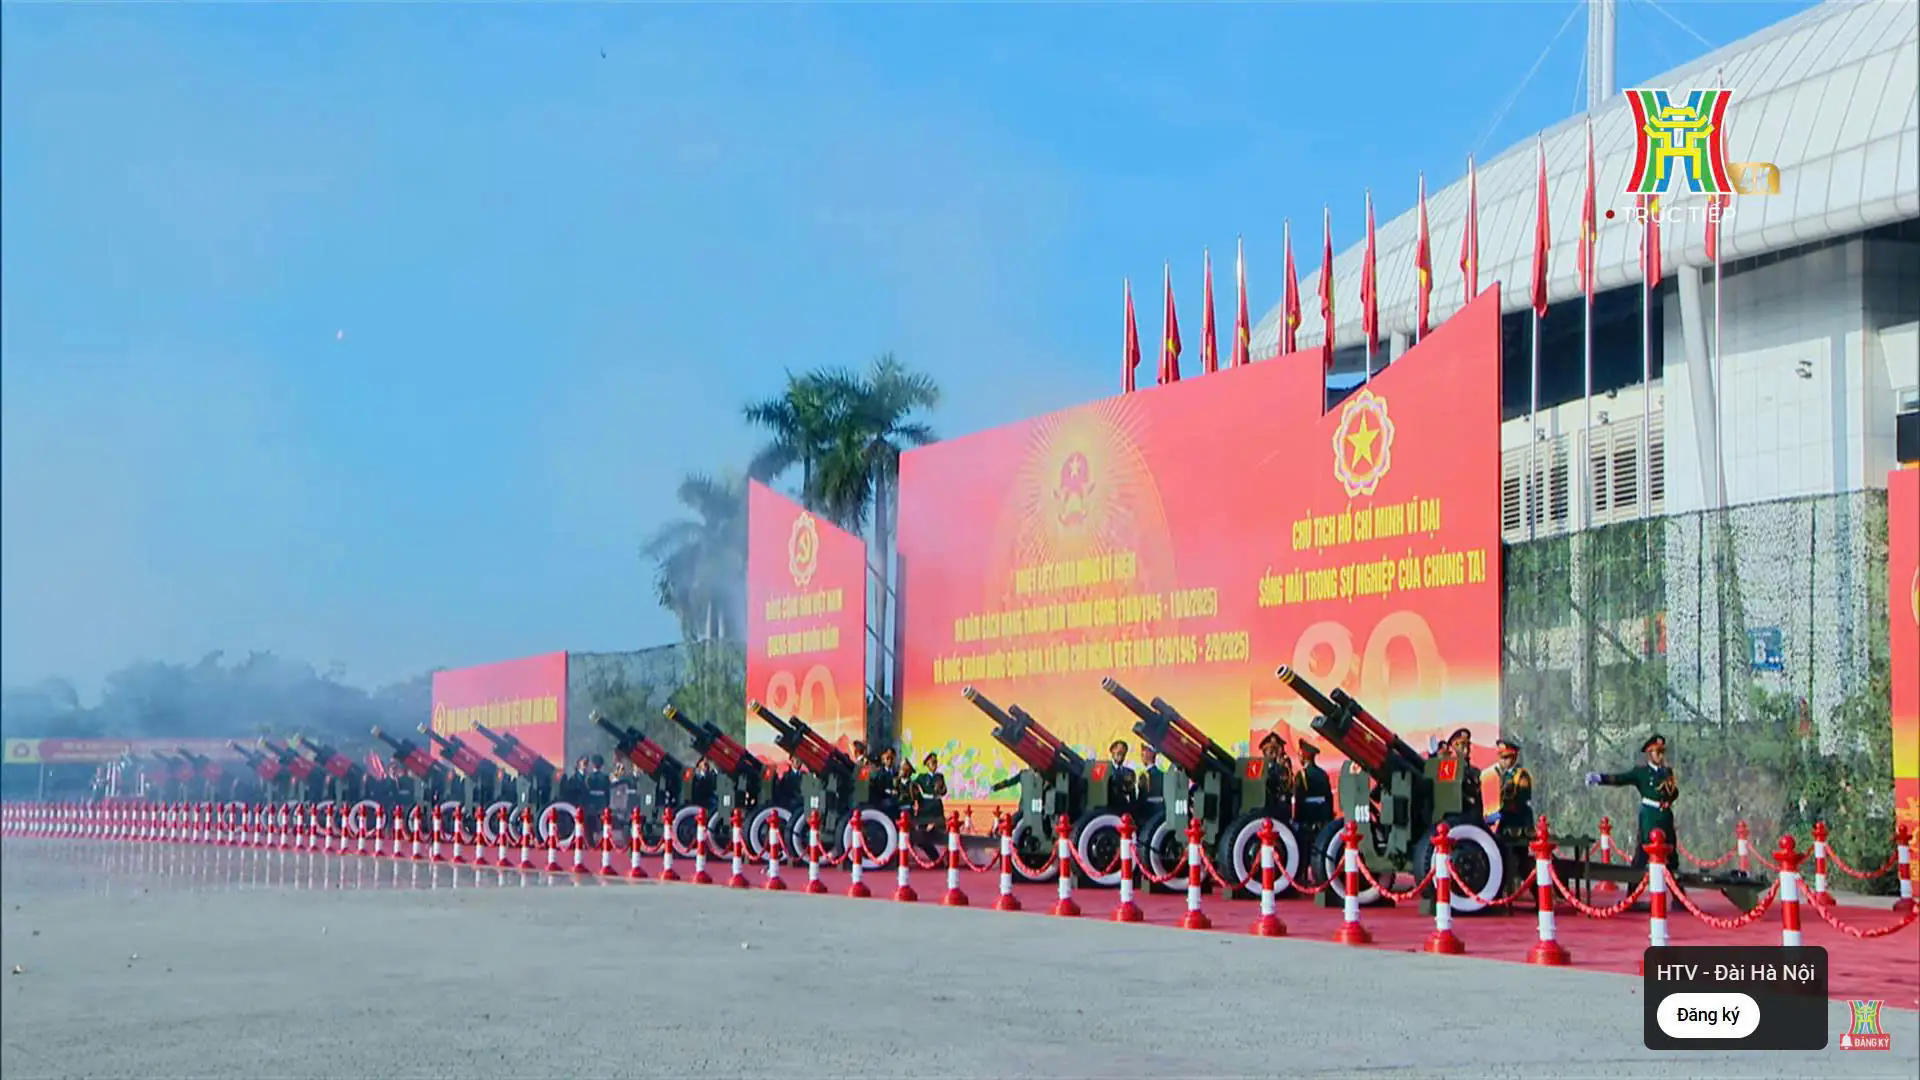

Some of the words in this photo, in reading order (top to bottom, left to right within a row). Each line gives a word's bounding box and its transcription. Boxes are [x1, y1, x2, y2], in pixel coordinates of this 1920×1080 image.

[1292, 509, 1312, 551] CHỦ
[1314, 515, 1336, 556] TỊCH
[1354, 501, 1373, 545] CHÍ
[1375, 503, 1404, 539] MINH
[1420, 498, 1440, 539] ĐẠI
[1305, 569, 1338, 601] TRONG
[1356, 553, 1396, 600] NGHIỆP
[1398, 547, 1421, 590] CỦA
[1423, 547, 1464, 588] CHÚNG
[1467, 548, 1486, 583] TA!
